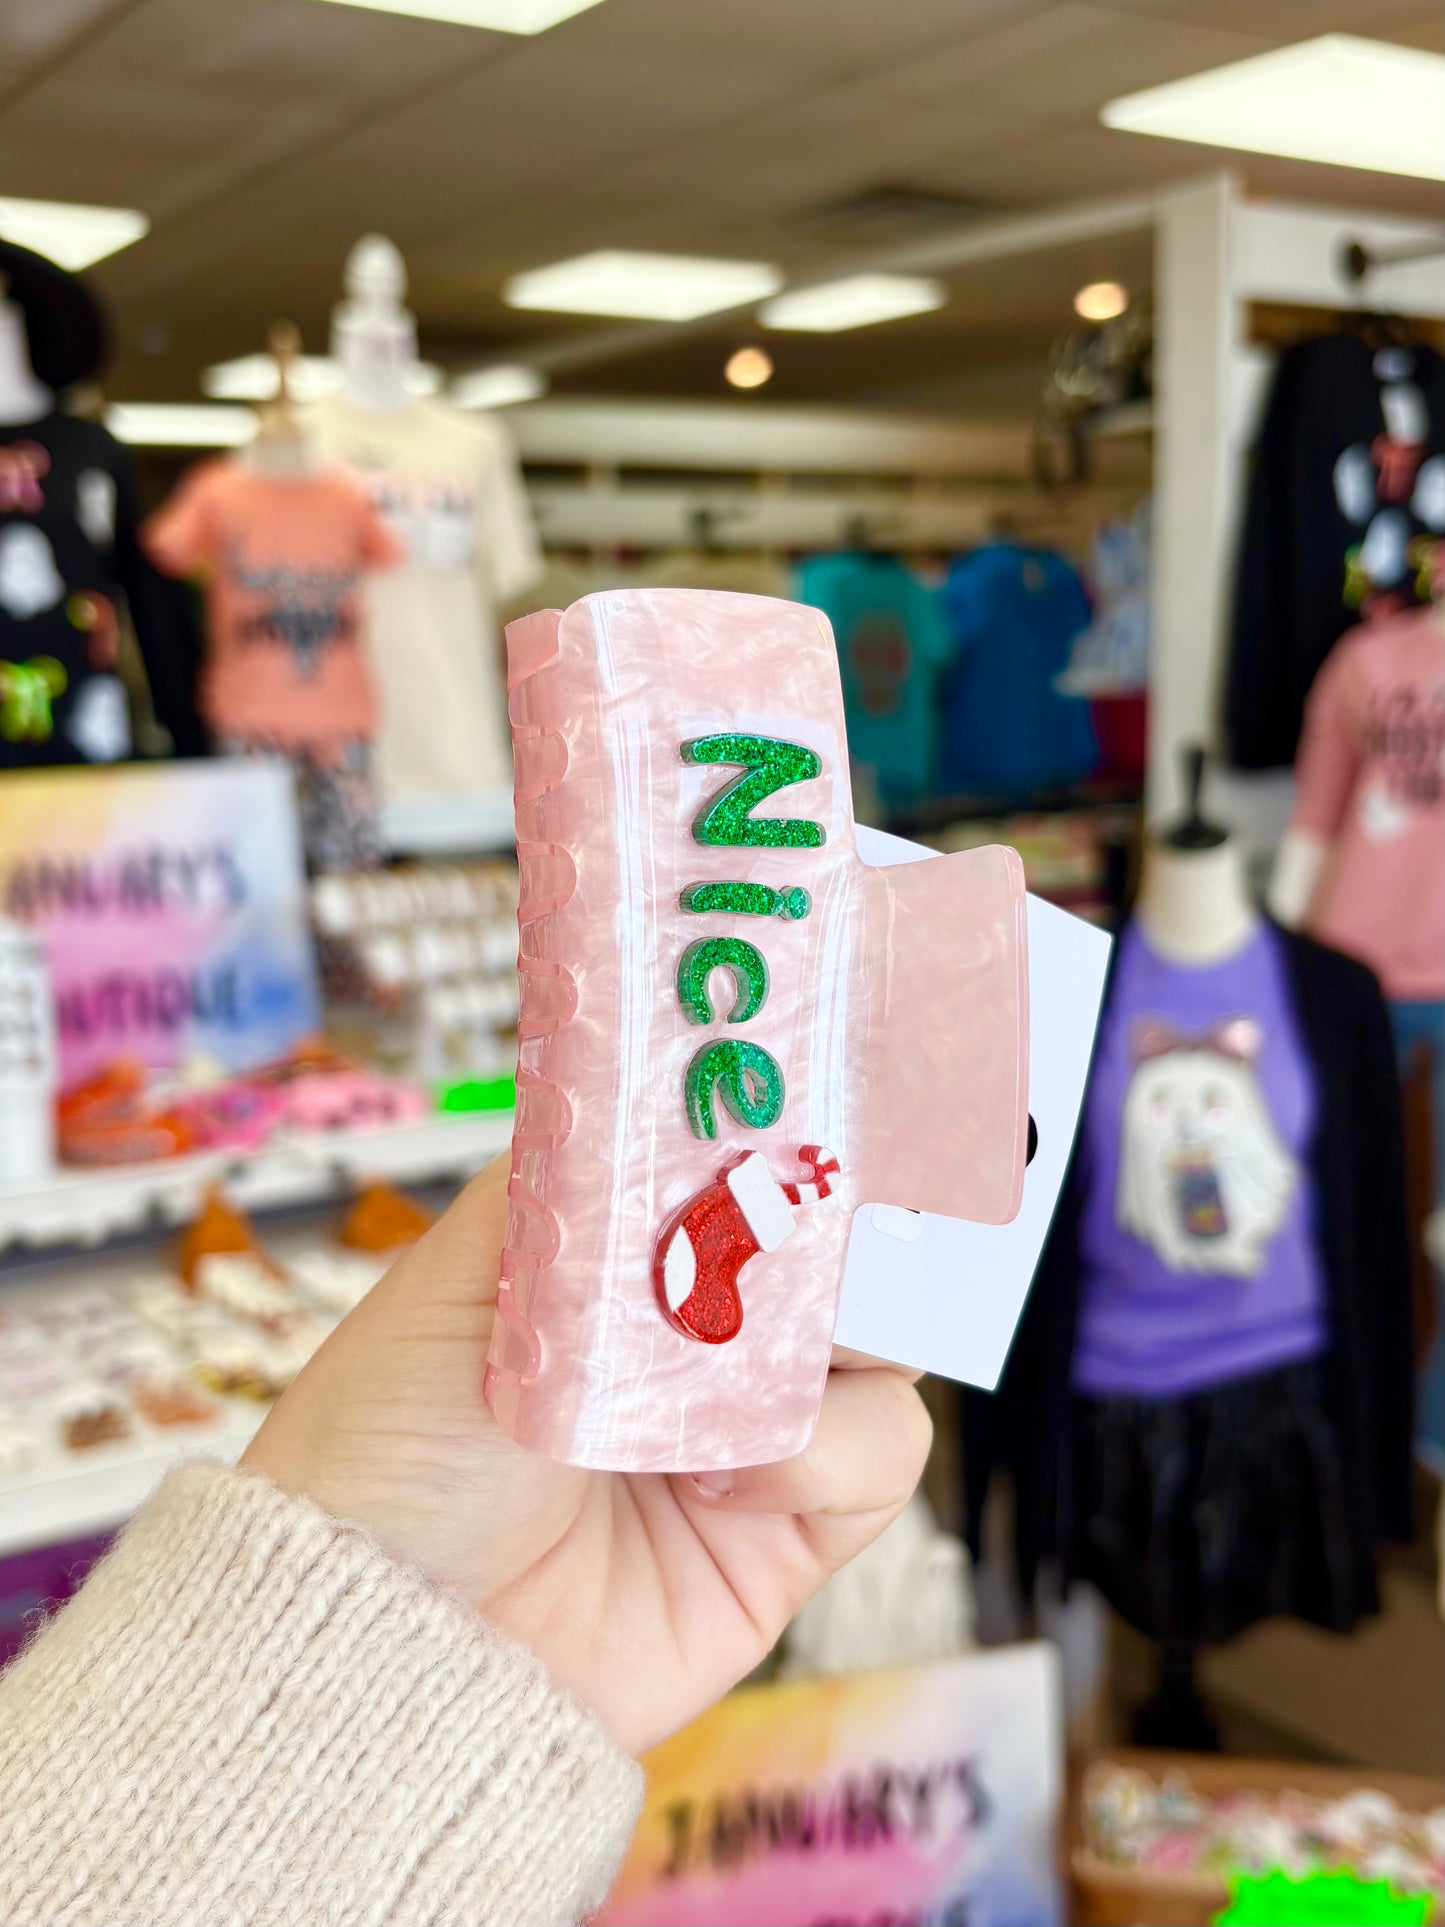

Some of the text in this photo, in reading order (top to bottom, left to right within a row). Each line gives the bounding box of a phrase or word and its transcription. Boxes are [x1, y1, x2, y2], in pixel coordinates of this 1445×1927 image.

[2, 842, 248, 922] ANUARY'S
[679, 732, 827, 1141] Nice
[56, 966, 239, 1040] UTIQUE
